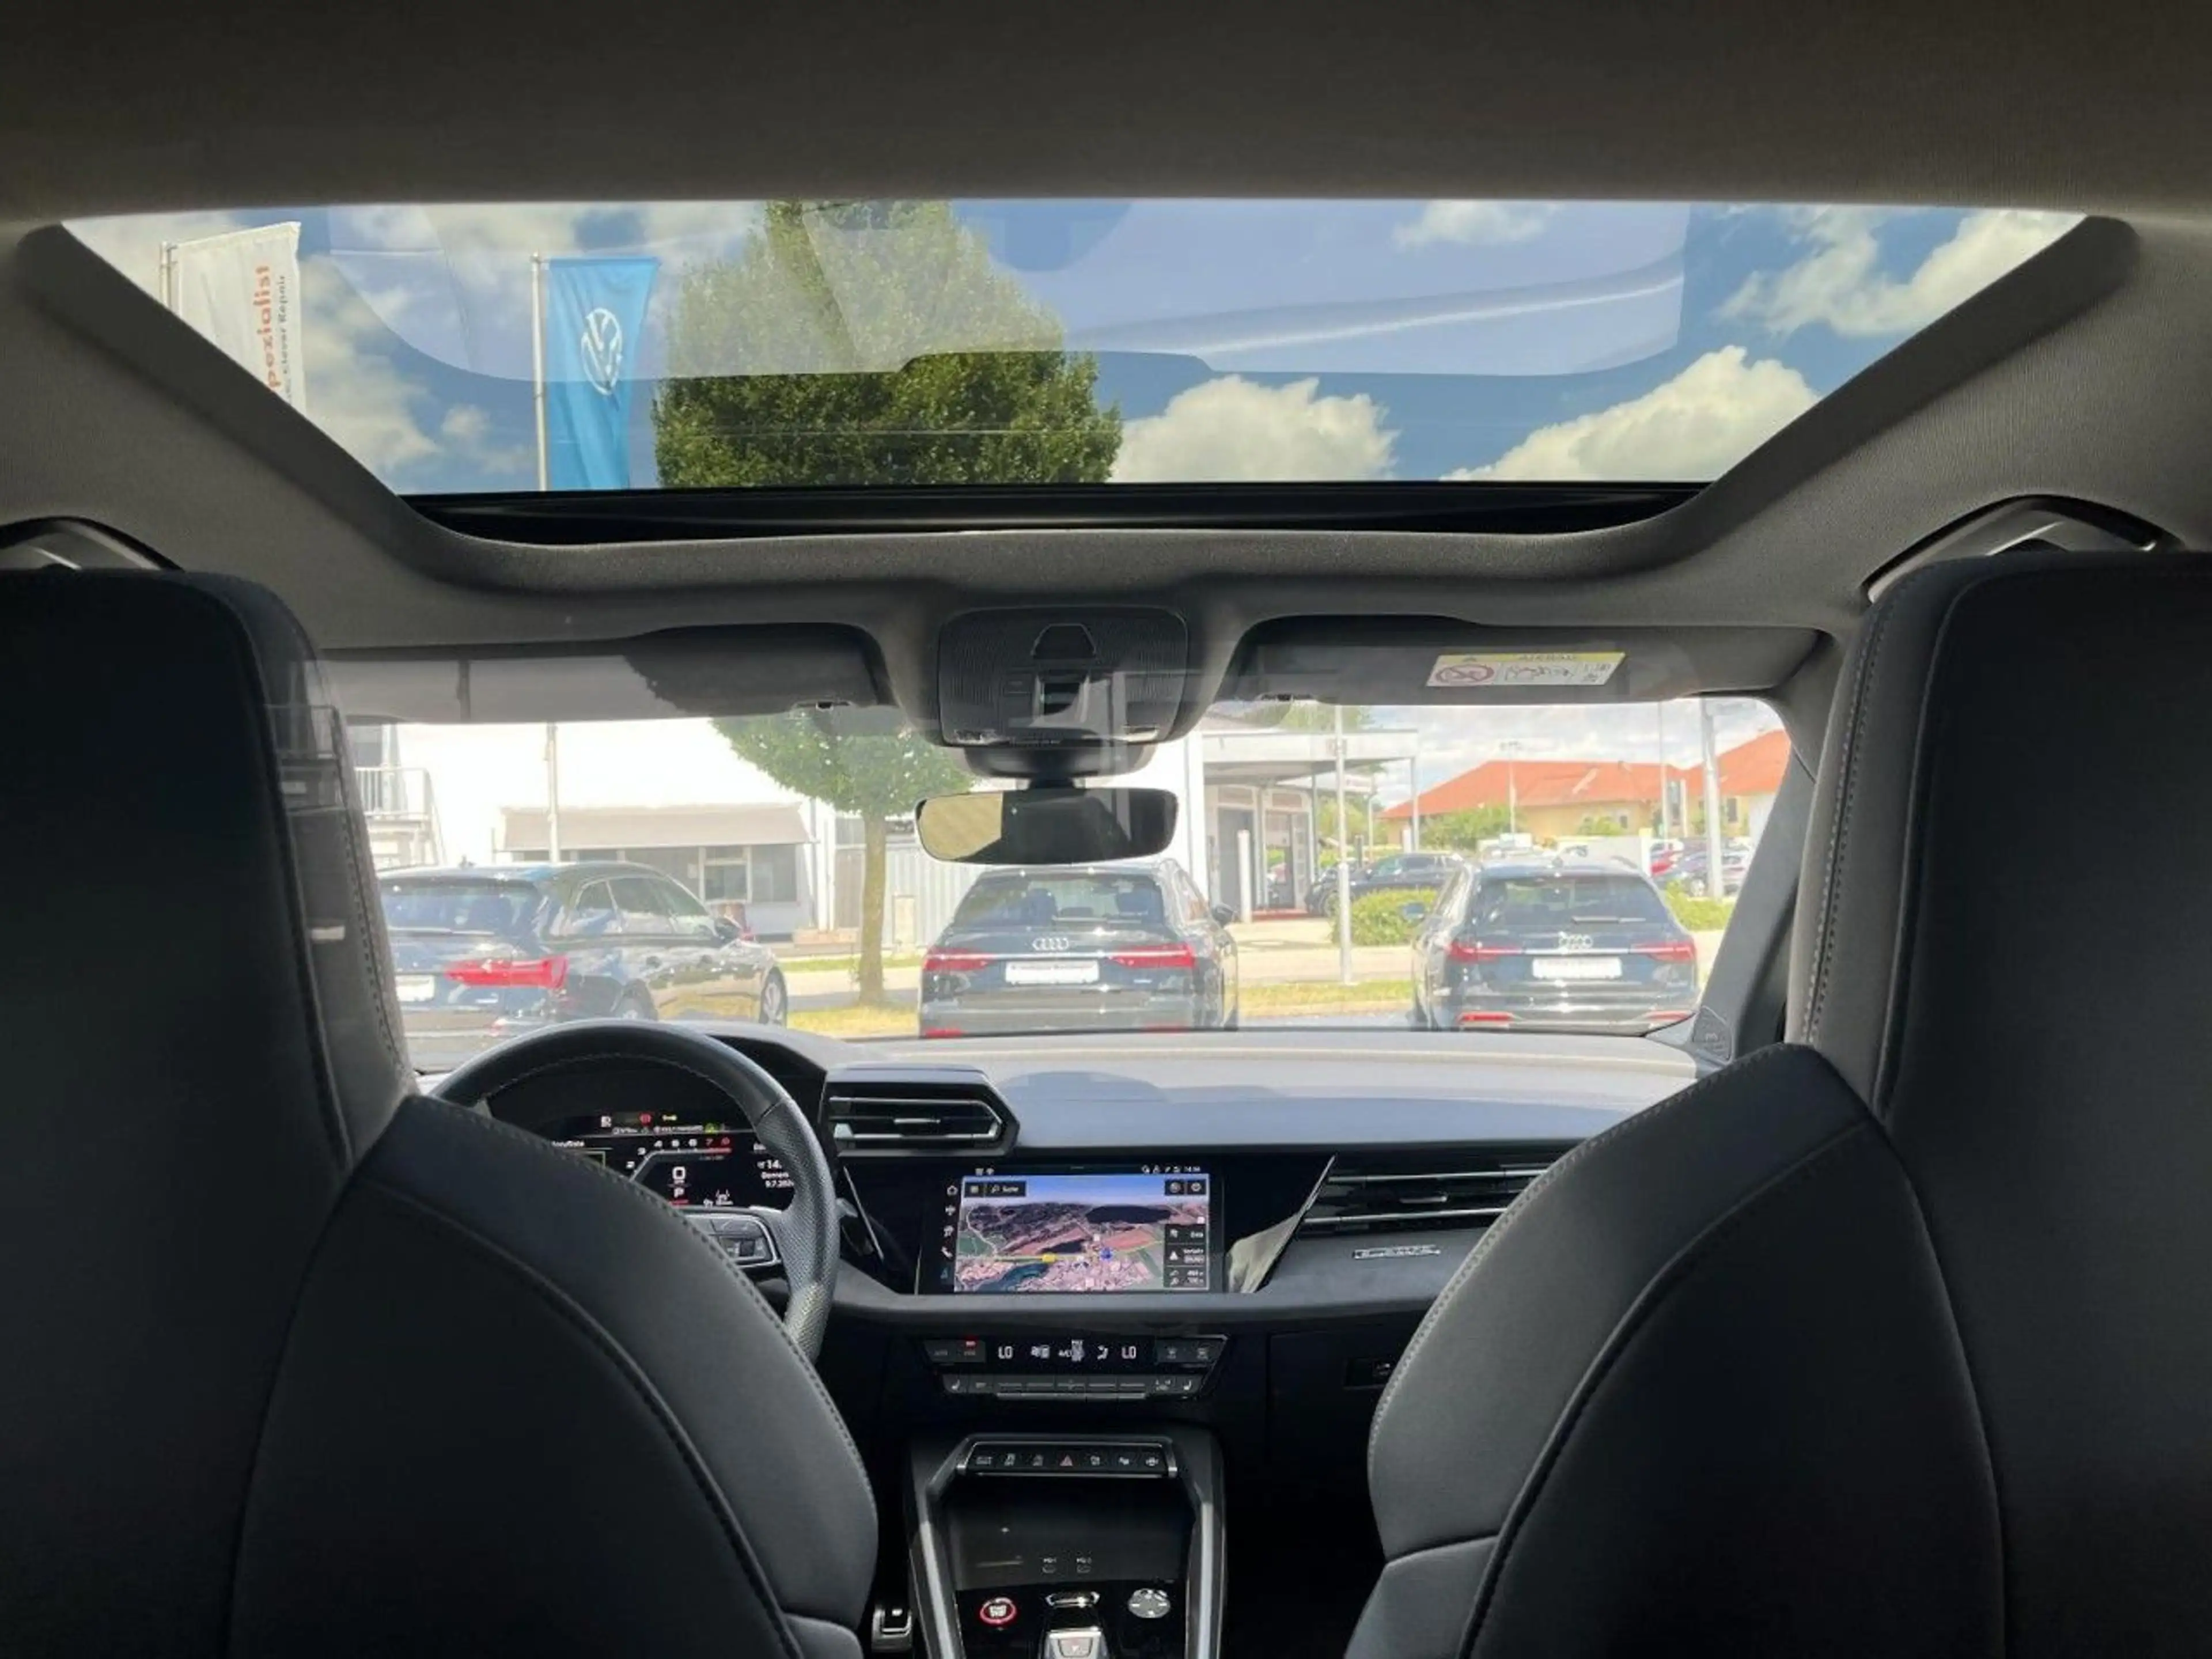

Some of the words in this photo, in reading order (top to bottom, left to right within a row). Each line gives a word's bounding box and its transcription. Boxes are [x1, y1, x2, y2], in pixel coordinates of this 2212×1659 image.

[253, 265, 282, 388] pezialist
[706, 1138, 714, 1147] 7
[672, 1166, 686, 1180] 0
[998, 1346, 1013, 1359] LO
[1122, 1346, 1137, 1359] LO
